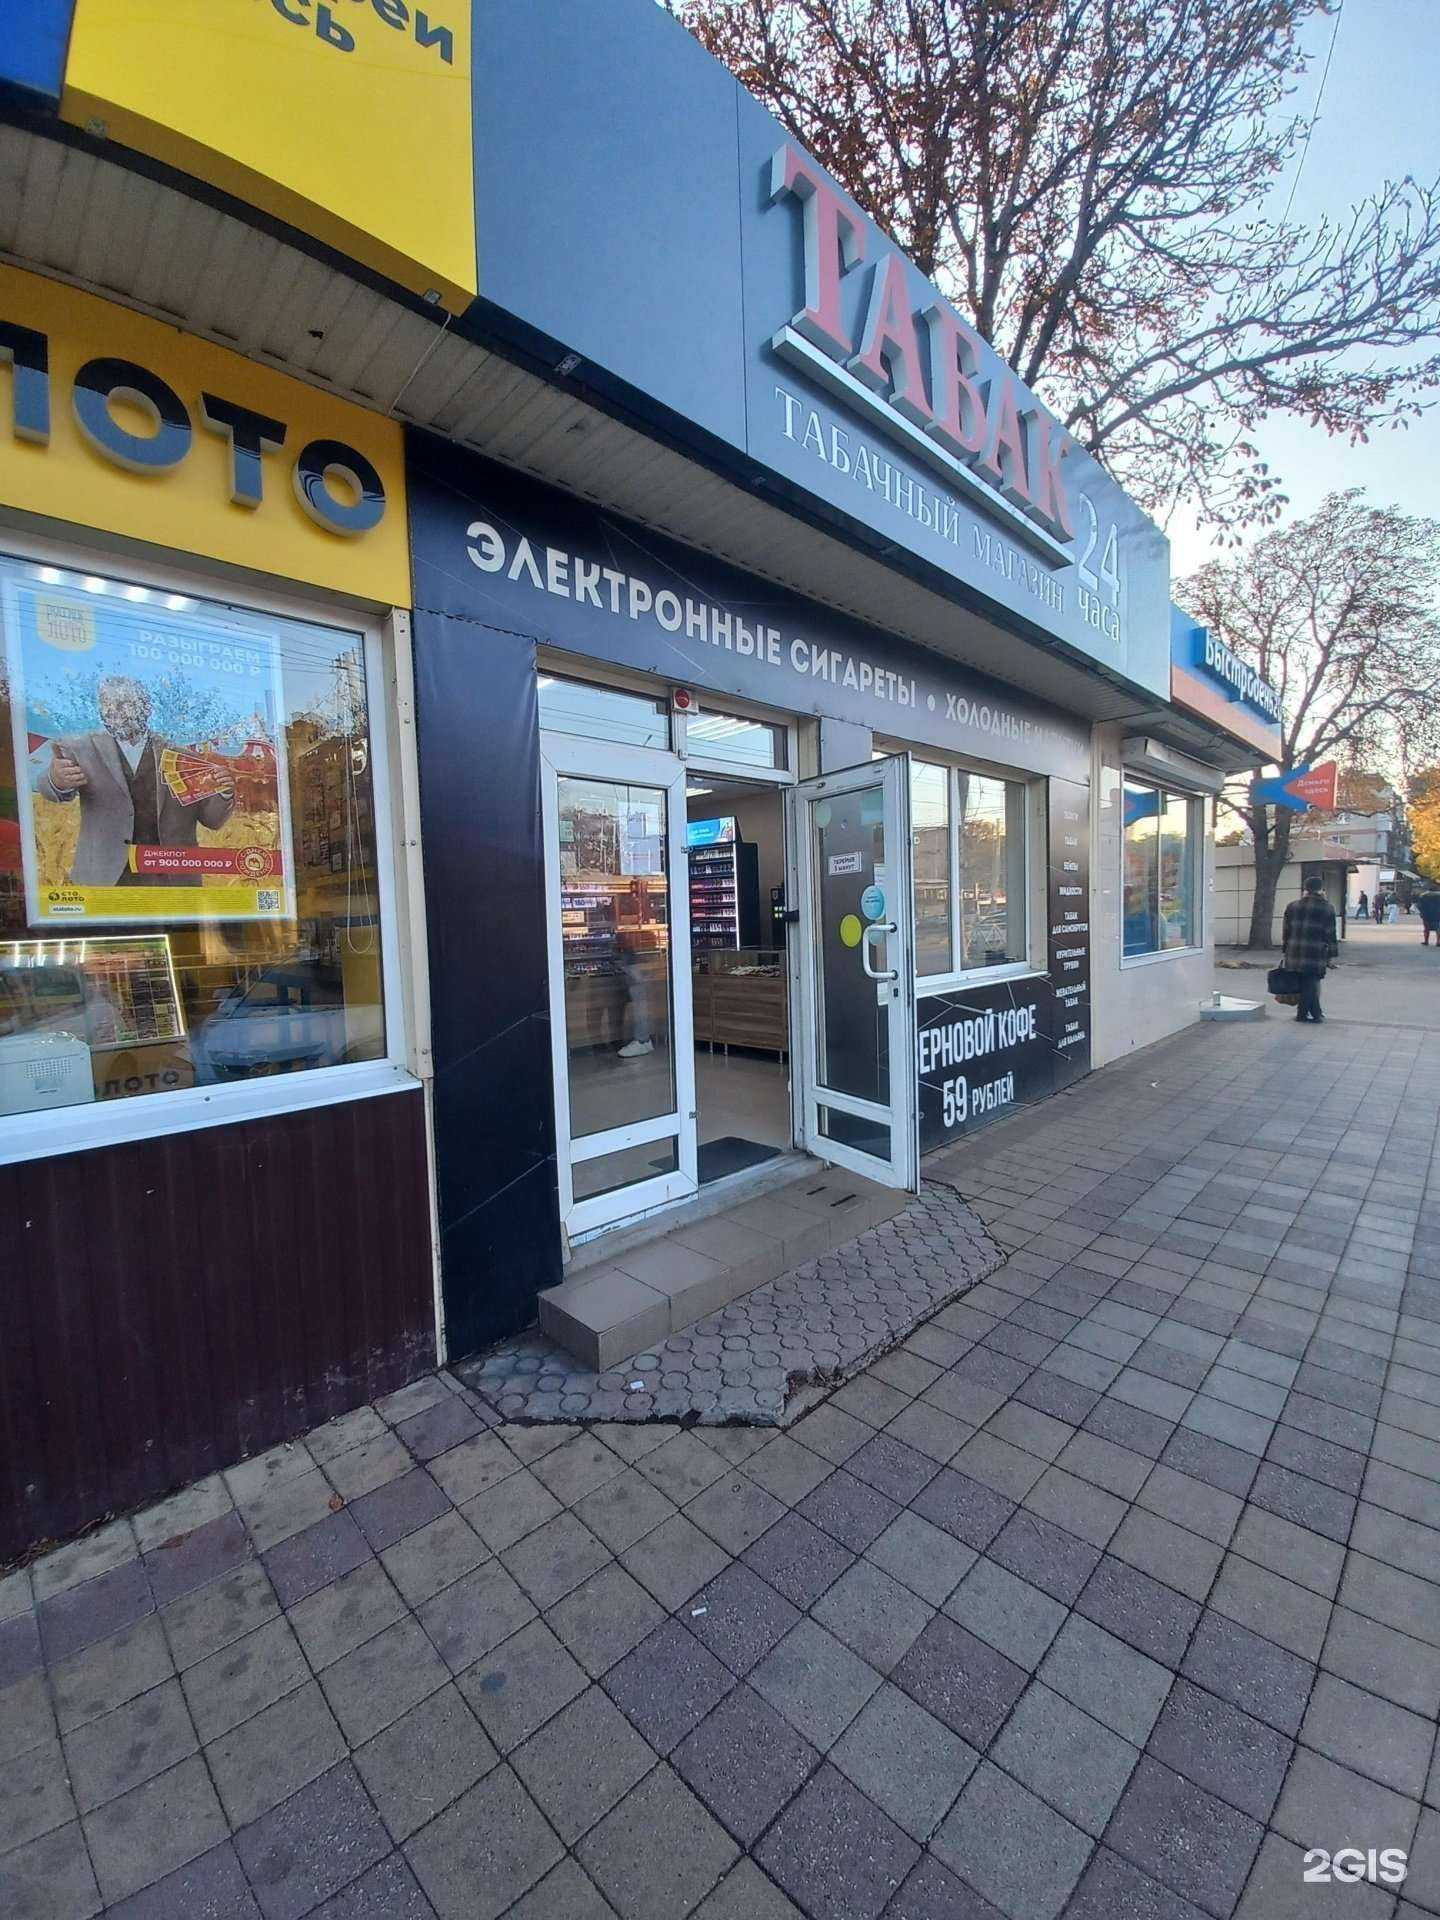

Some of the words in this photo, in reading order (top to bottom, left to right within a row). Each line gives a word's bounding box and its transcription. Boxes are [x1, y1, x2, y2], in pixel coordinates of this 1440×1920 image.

[770, 143, 1074, 543] ТАБАК
[775, 386, 959, 547] ТАБАЧНЫЙ
[972, 524, 1065, 616] МАГАЗИН
[1079, 493, 1121, 606] 24
[465, 521, 782, 666] ЭЛЕКТРОННЫЕ
[790, 638, 916, 709] СИГАРЕТЫ
[945, 693, 1033, 745] ХОЛОДНЫЕ
[1077, 583, 1121, 643] часа
[128, 643, 161, 660] 100
[168, 650, 205, 667] 000
[211, 656, 243, 674] 000
[139, 630, 261, 664] РАЗЫГРАЕМ
[144, 850, 187, 858] ДЖЕКПОТ
[159, 858, 179, 867] 900
[182, 859, 202, 867] 000
[204, 859, 224, 867] 000
[918, 1008, 996, 1075] ЕРНОВОЙ
[999, 1004, 1037, 1048] КОФЕ
[943, 1075, 968, 1128] 59
[971, 1071, 1015, 1117] РУБЛЕЙ
